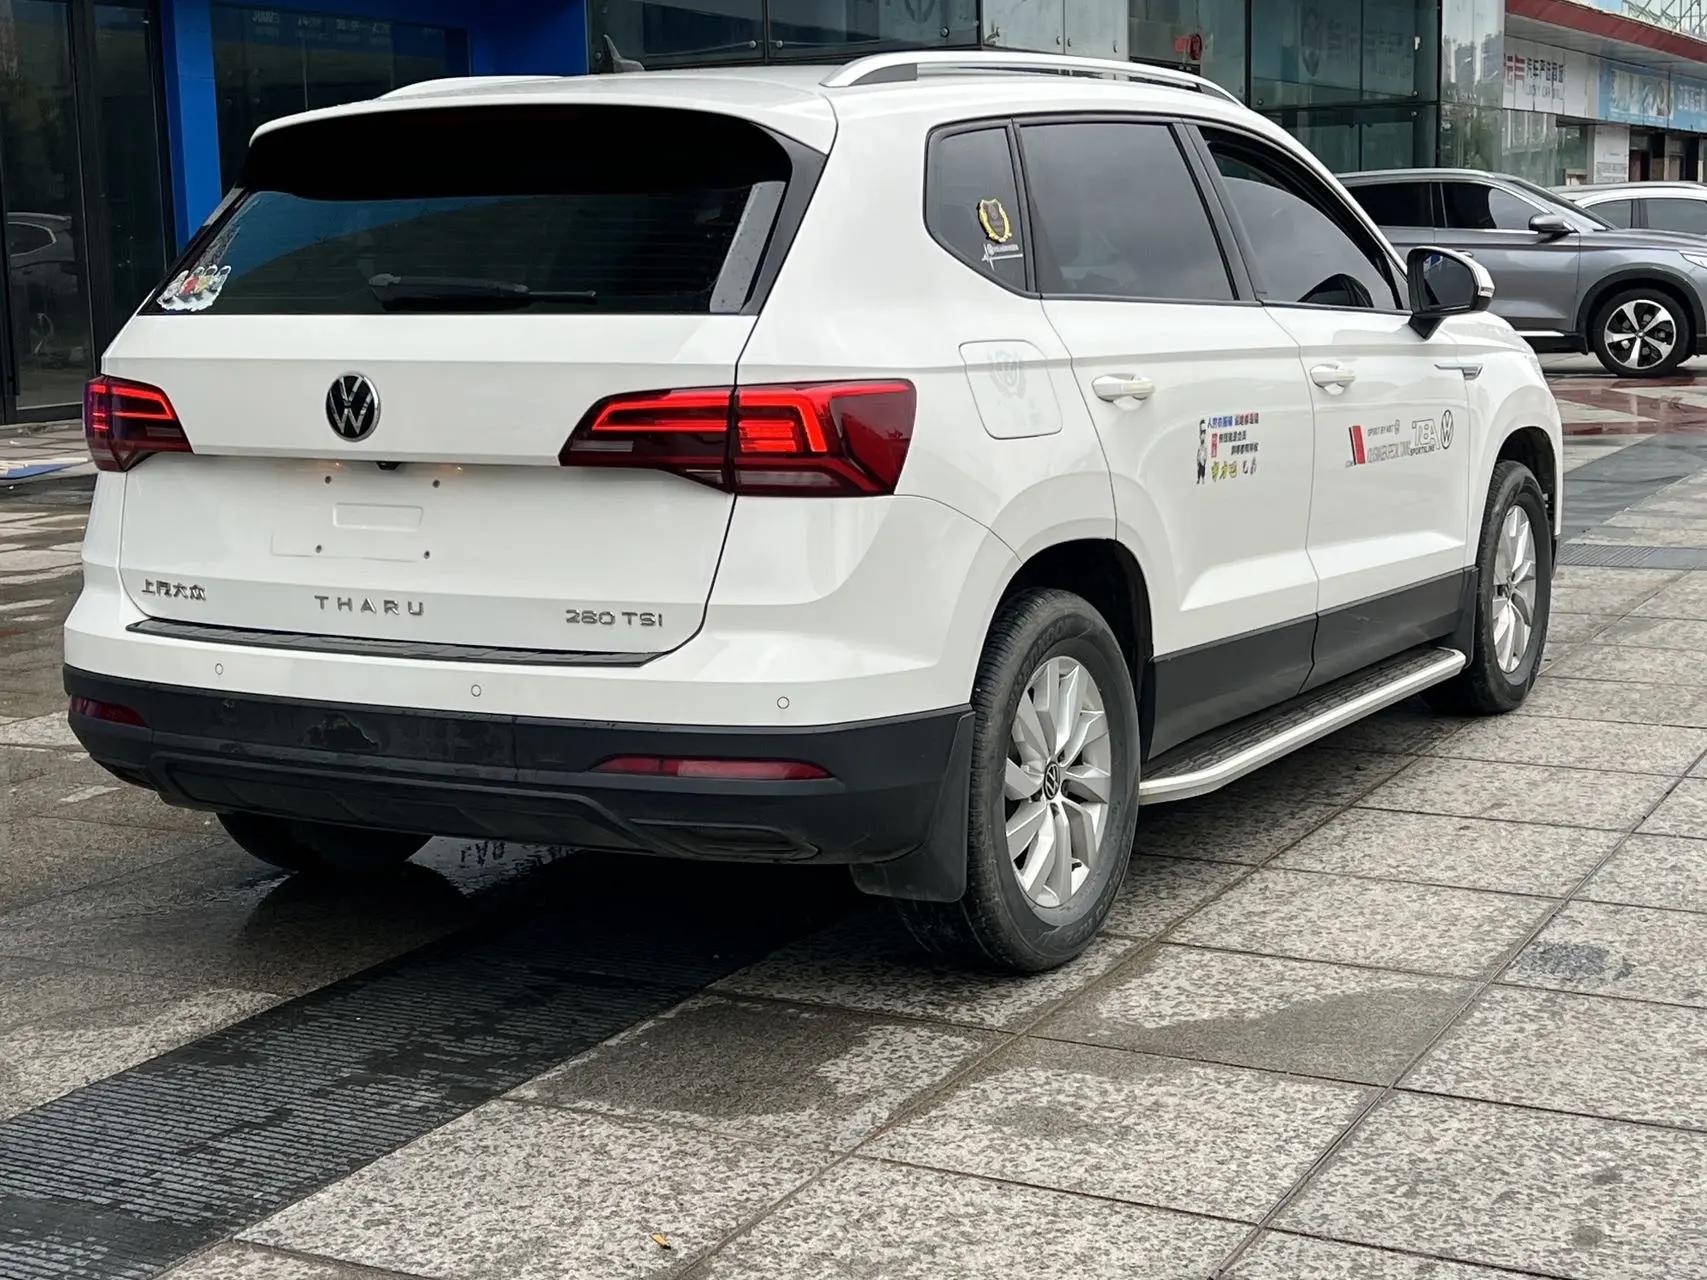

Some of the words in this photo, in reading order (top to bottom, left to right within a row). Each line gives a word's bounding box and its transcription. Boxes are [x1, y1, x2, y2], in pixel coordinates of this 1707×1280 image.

[314, 595, 424, 616] THARU
[566, 609, 615, 625] 280
[621, 611, 663, 627] TSI
